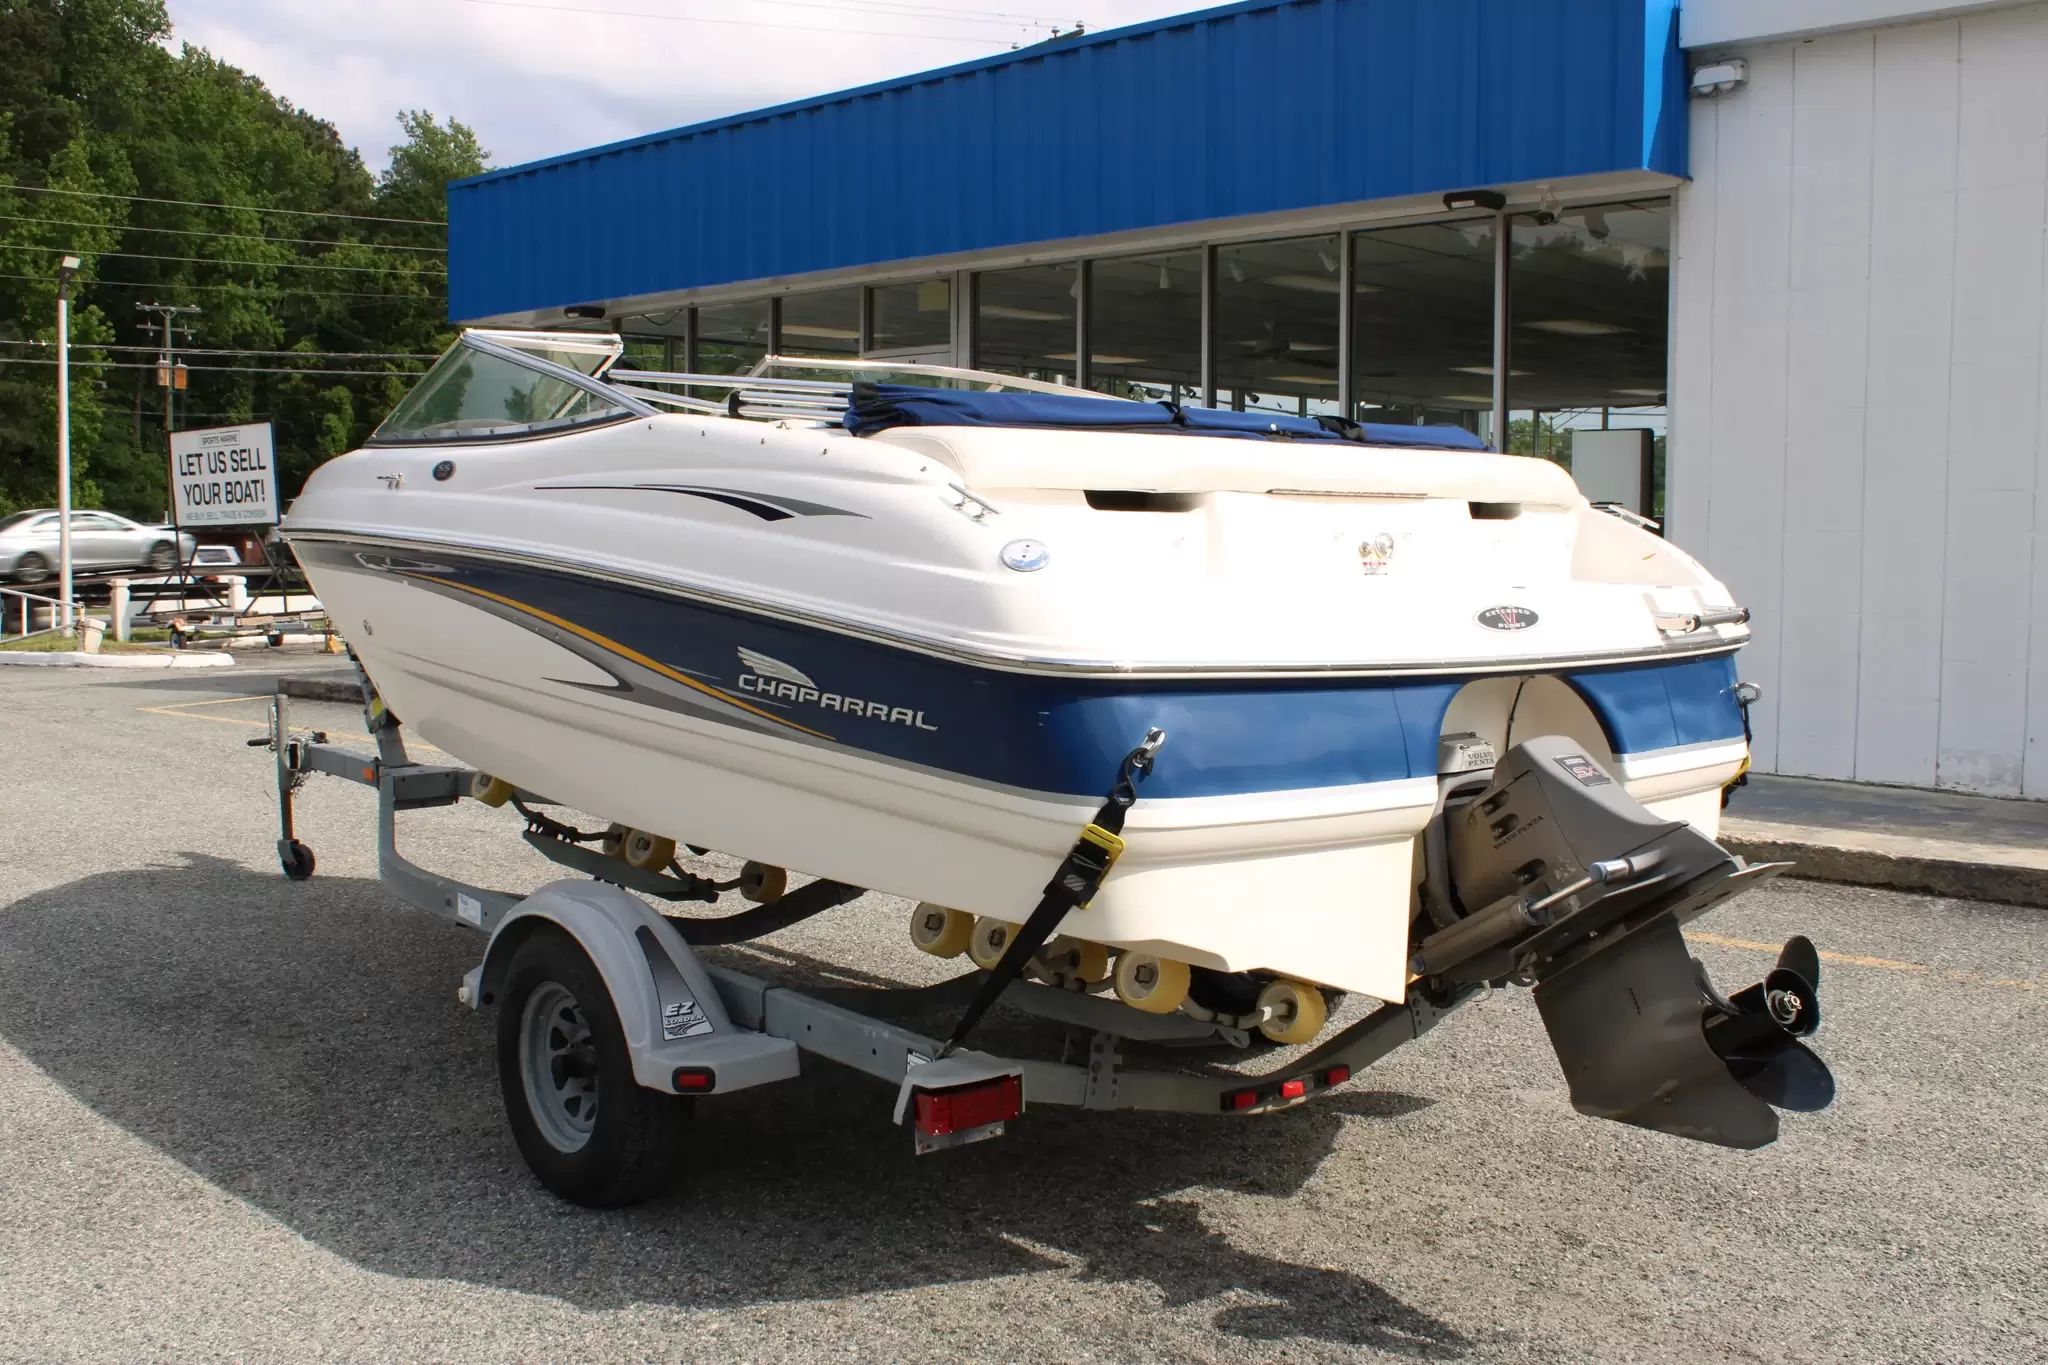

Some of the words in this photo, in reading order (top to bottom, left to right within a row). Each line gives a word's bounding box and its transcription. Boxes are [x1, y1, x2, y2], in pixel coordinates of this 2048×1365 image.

[179, 453, 203, 476] LET
[207, 451, 227, 474] US
[230, 448, 266, 472] SELL
[183, 482, 221, 506] YOUR
[225, 479, 265, 504] BOAT!
[738, 673, 939, 731] CHAPARRAL
[1468, 751, 1493, 760] VOLVO
[1468, 758, 1495, 767] PENTA
[664, 1001, 697, 1018] EZ
[665, 1014, 704, 1027] LOADER
